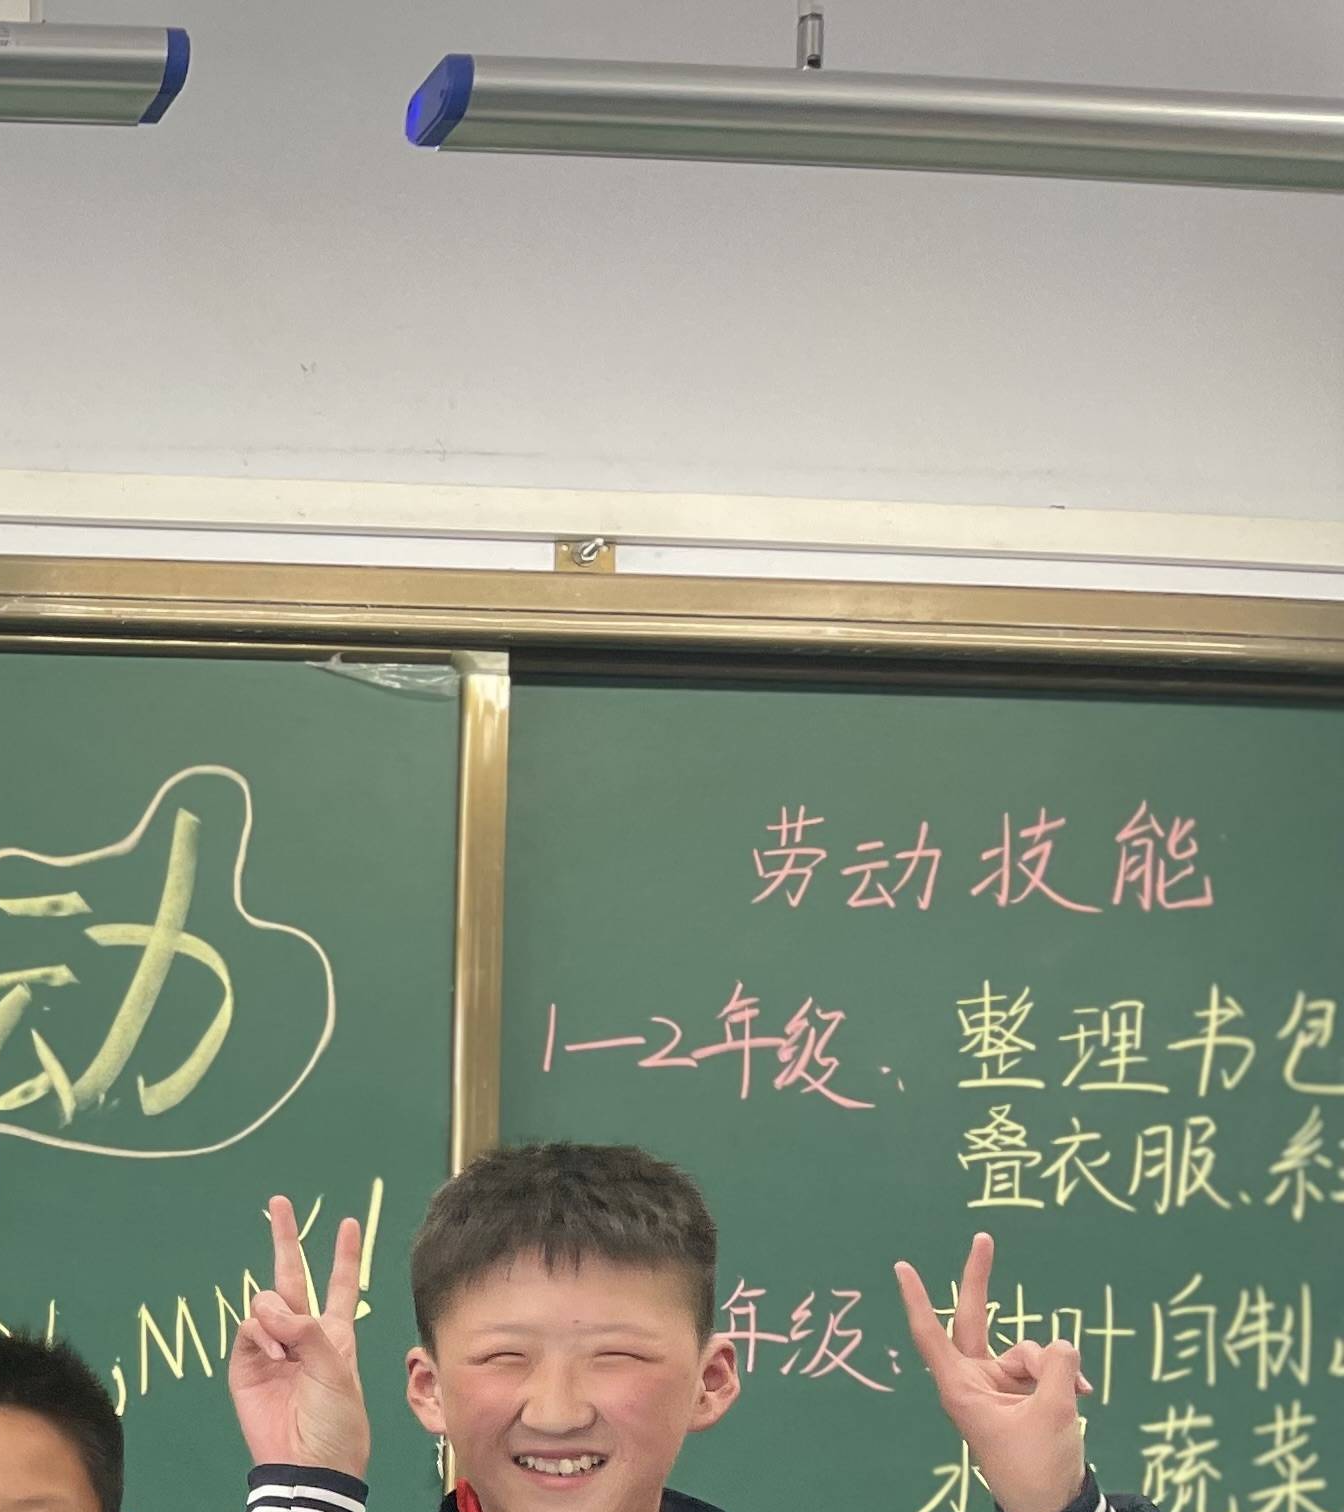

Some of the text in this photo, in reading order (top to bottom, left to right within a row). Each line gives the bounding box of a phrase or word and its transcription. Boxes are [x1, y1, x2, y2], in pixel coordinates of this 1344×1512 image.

[750, 801, 1215, 913] 劳动技能
[957, 979, 1344, 1097] 整理书包
